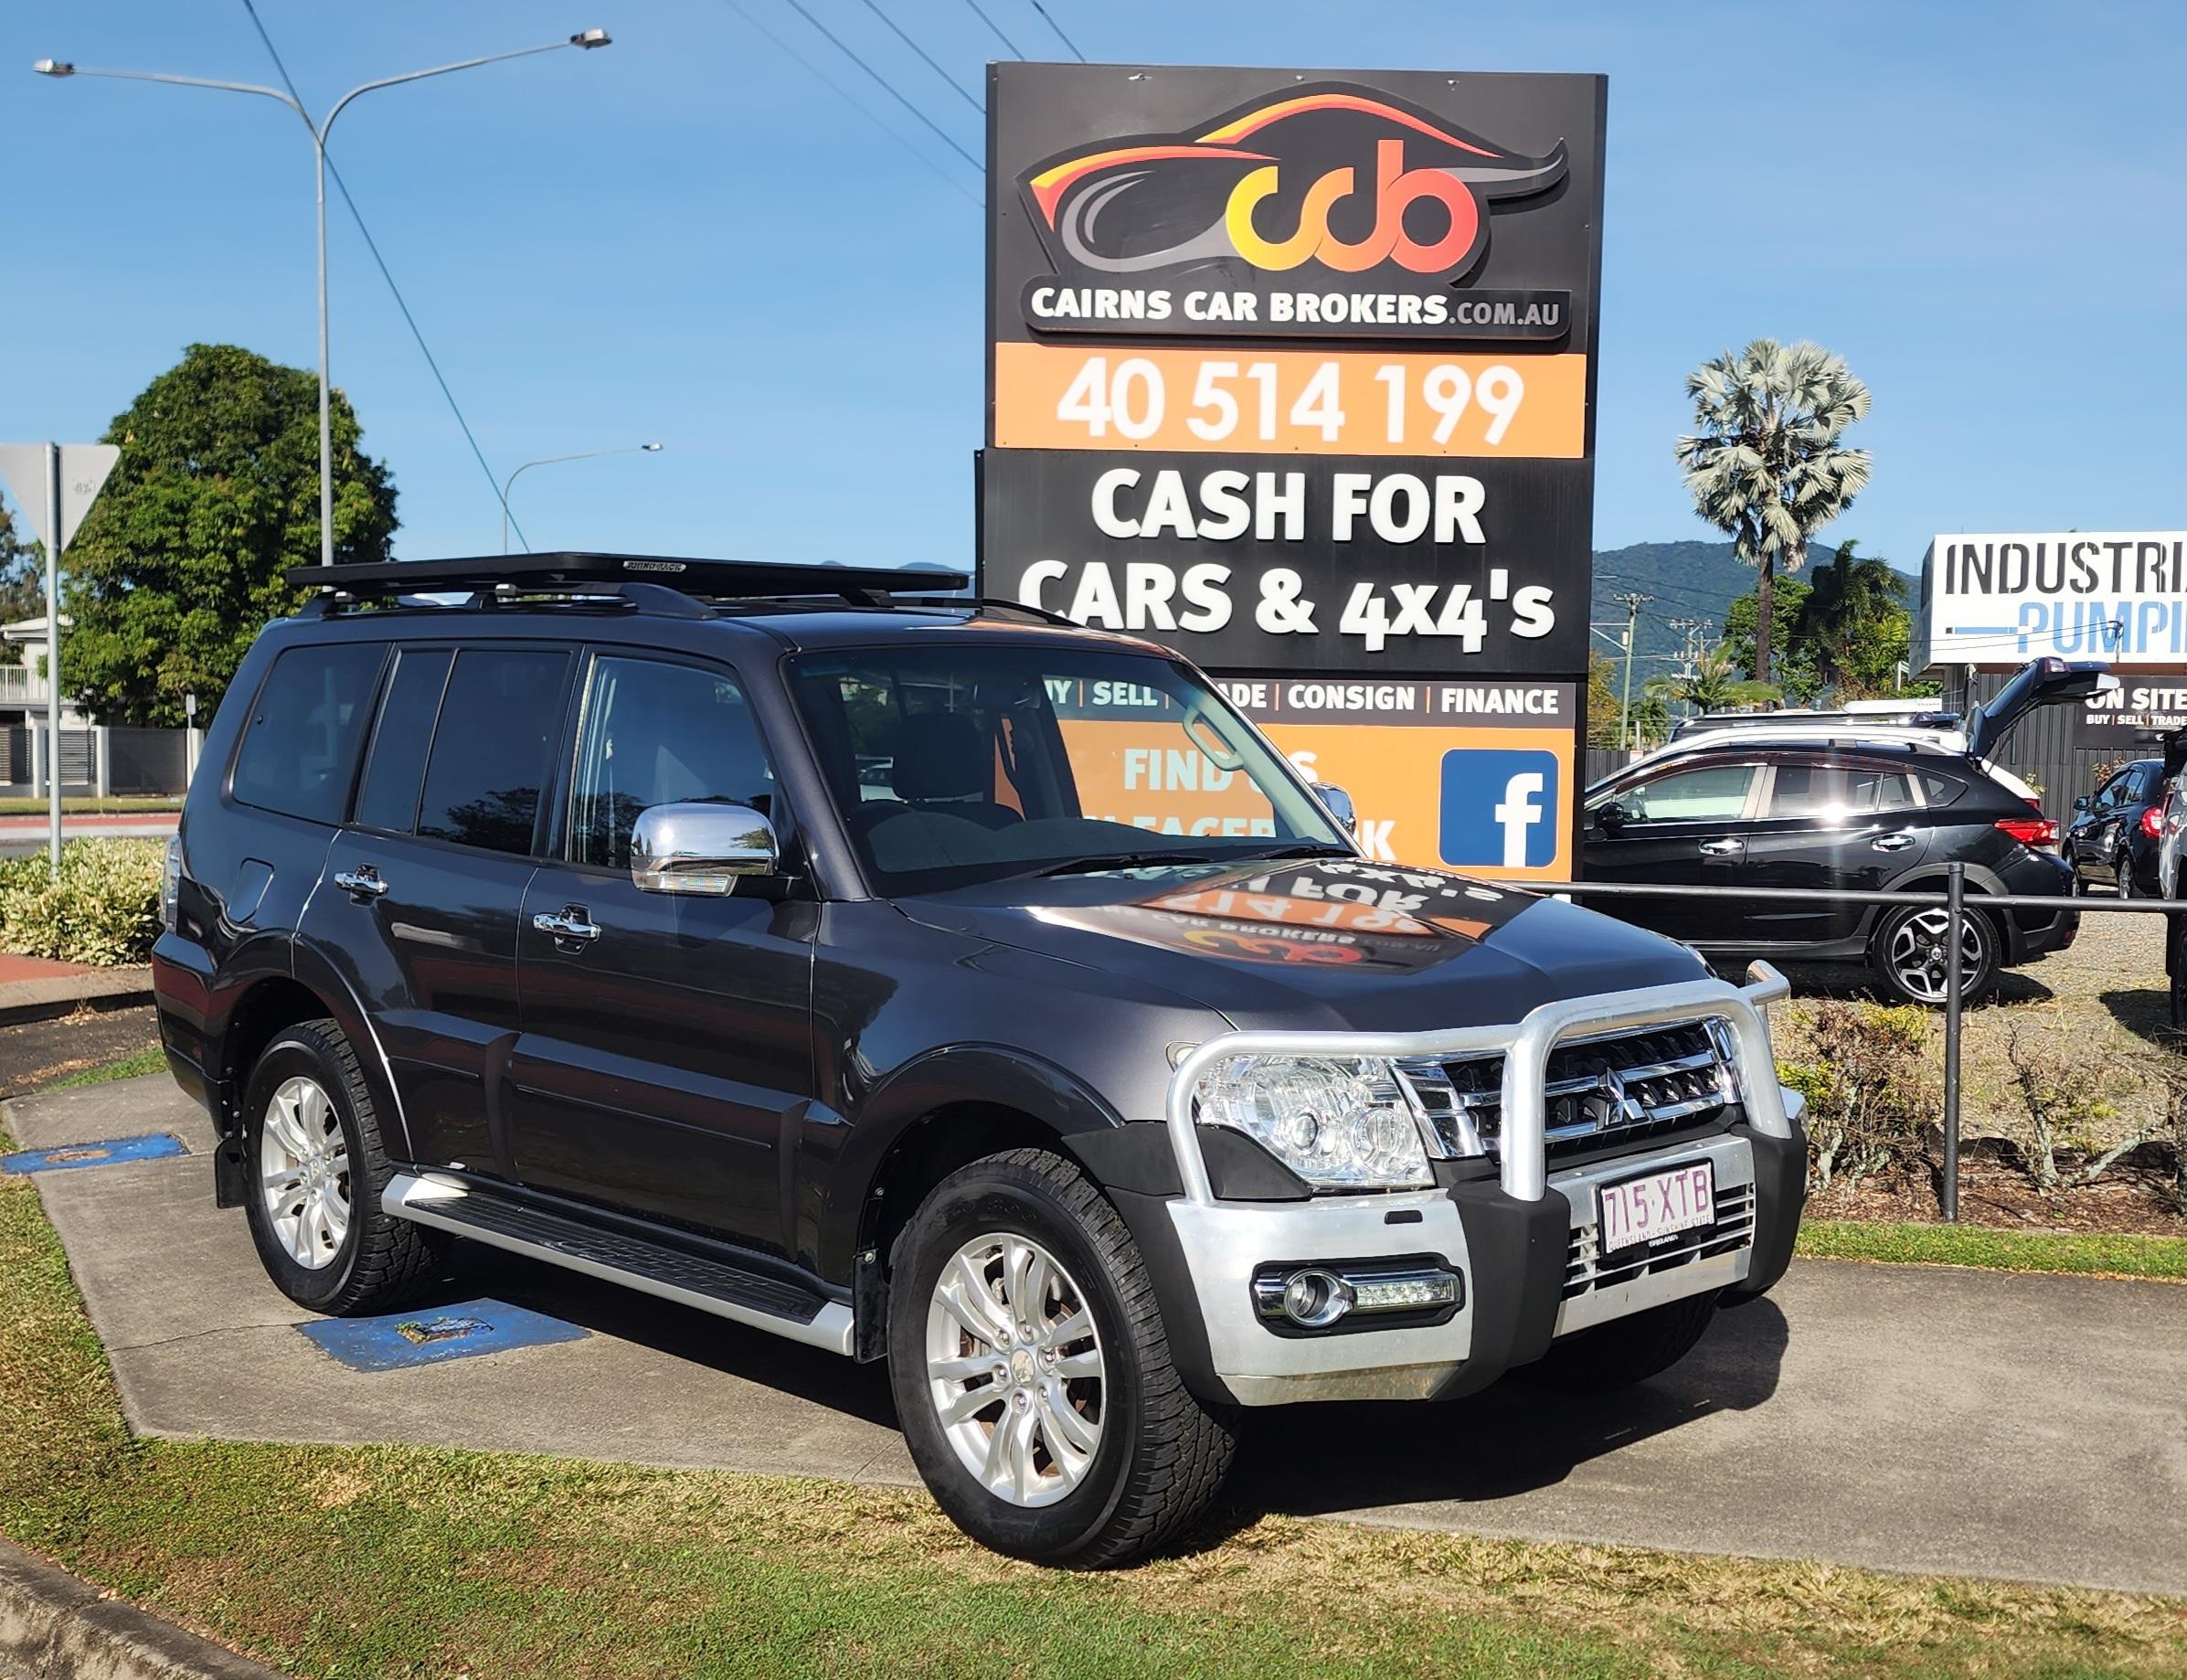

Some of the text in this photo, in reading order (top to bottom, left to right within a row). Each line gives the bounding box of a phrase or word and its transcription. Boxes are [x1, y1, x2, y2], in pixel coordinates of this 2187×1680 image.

[1031, 287, 1173, 320] CAIRNS
[1184, 291, 1258, 323] CAR
[1056, 356, 1525, 447] 40 514 199
[1091, 468, 1487, 545] CASH FOR
[1945, 540, 2187, 595] INDUSTRI
[1019, 559, 1234, 633] CARS
[1255, 568, 1319, 634] &
[2017, 601, 2187, 654] PUMPI
[1092, 679, 1159, 707] SELL
[1287, 684, 1416, 710] CONSIGN
[1440, 687, 1559, 715] FINANCE
[2085, 688, 2187, 711] ON SITE
[2086, 714, 2187, 727] BUY SELL TRADE
[1124, 749, 1234, 792] FIND
[1691, 1214, 1711, 1226] STATE
